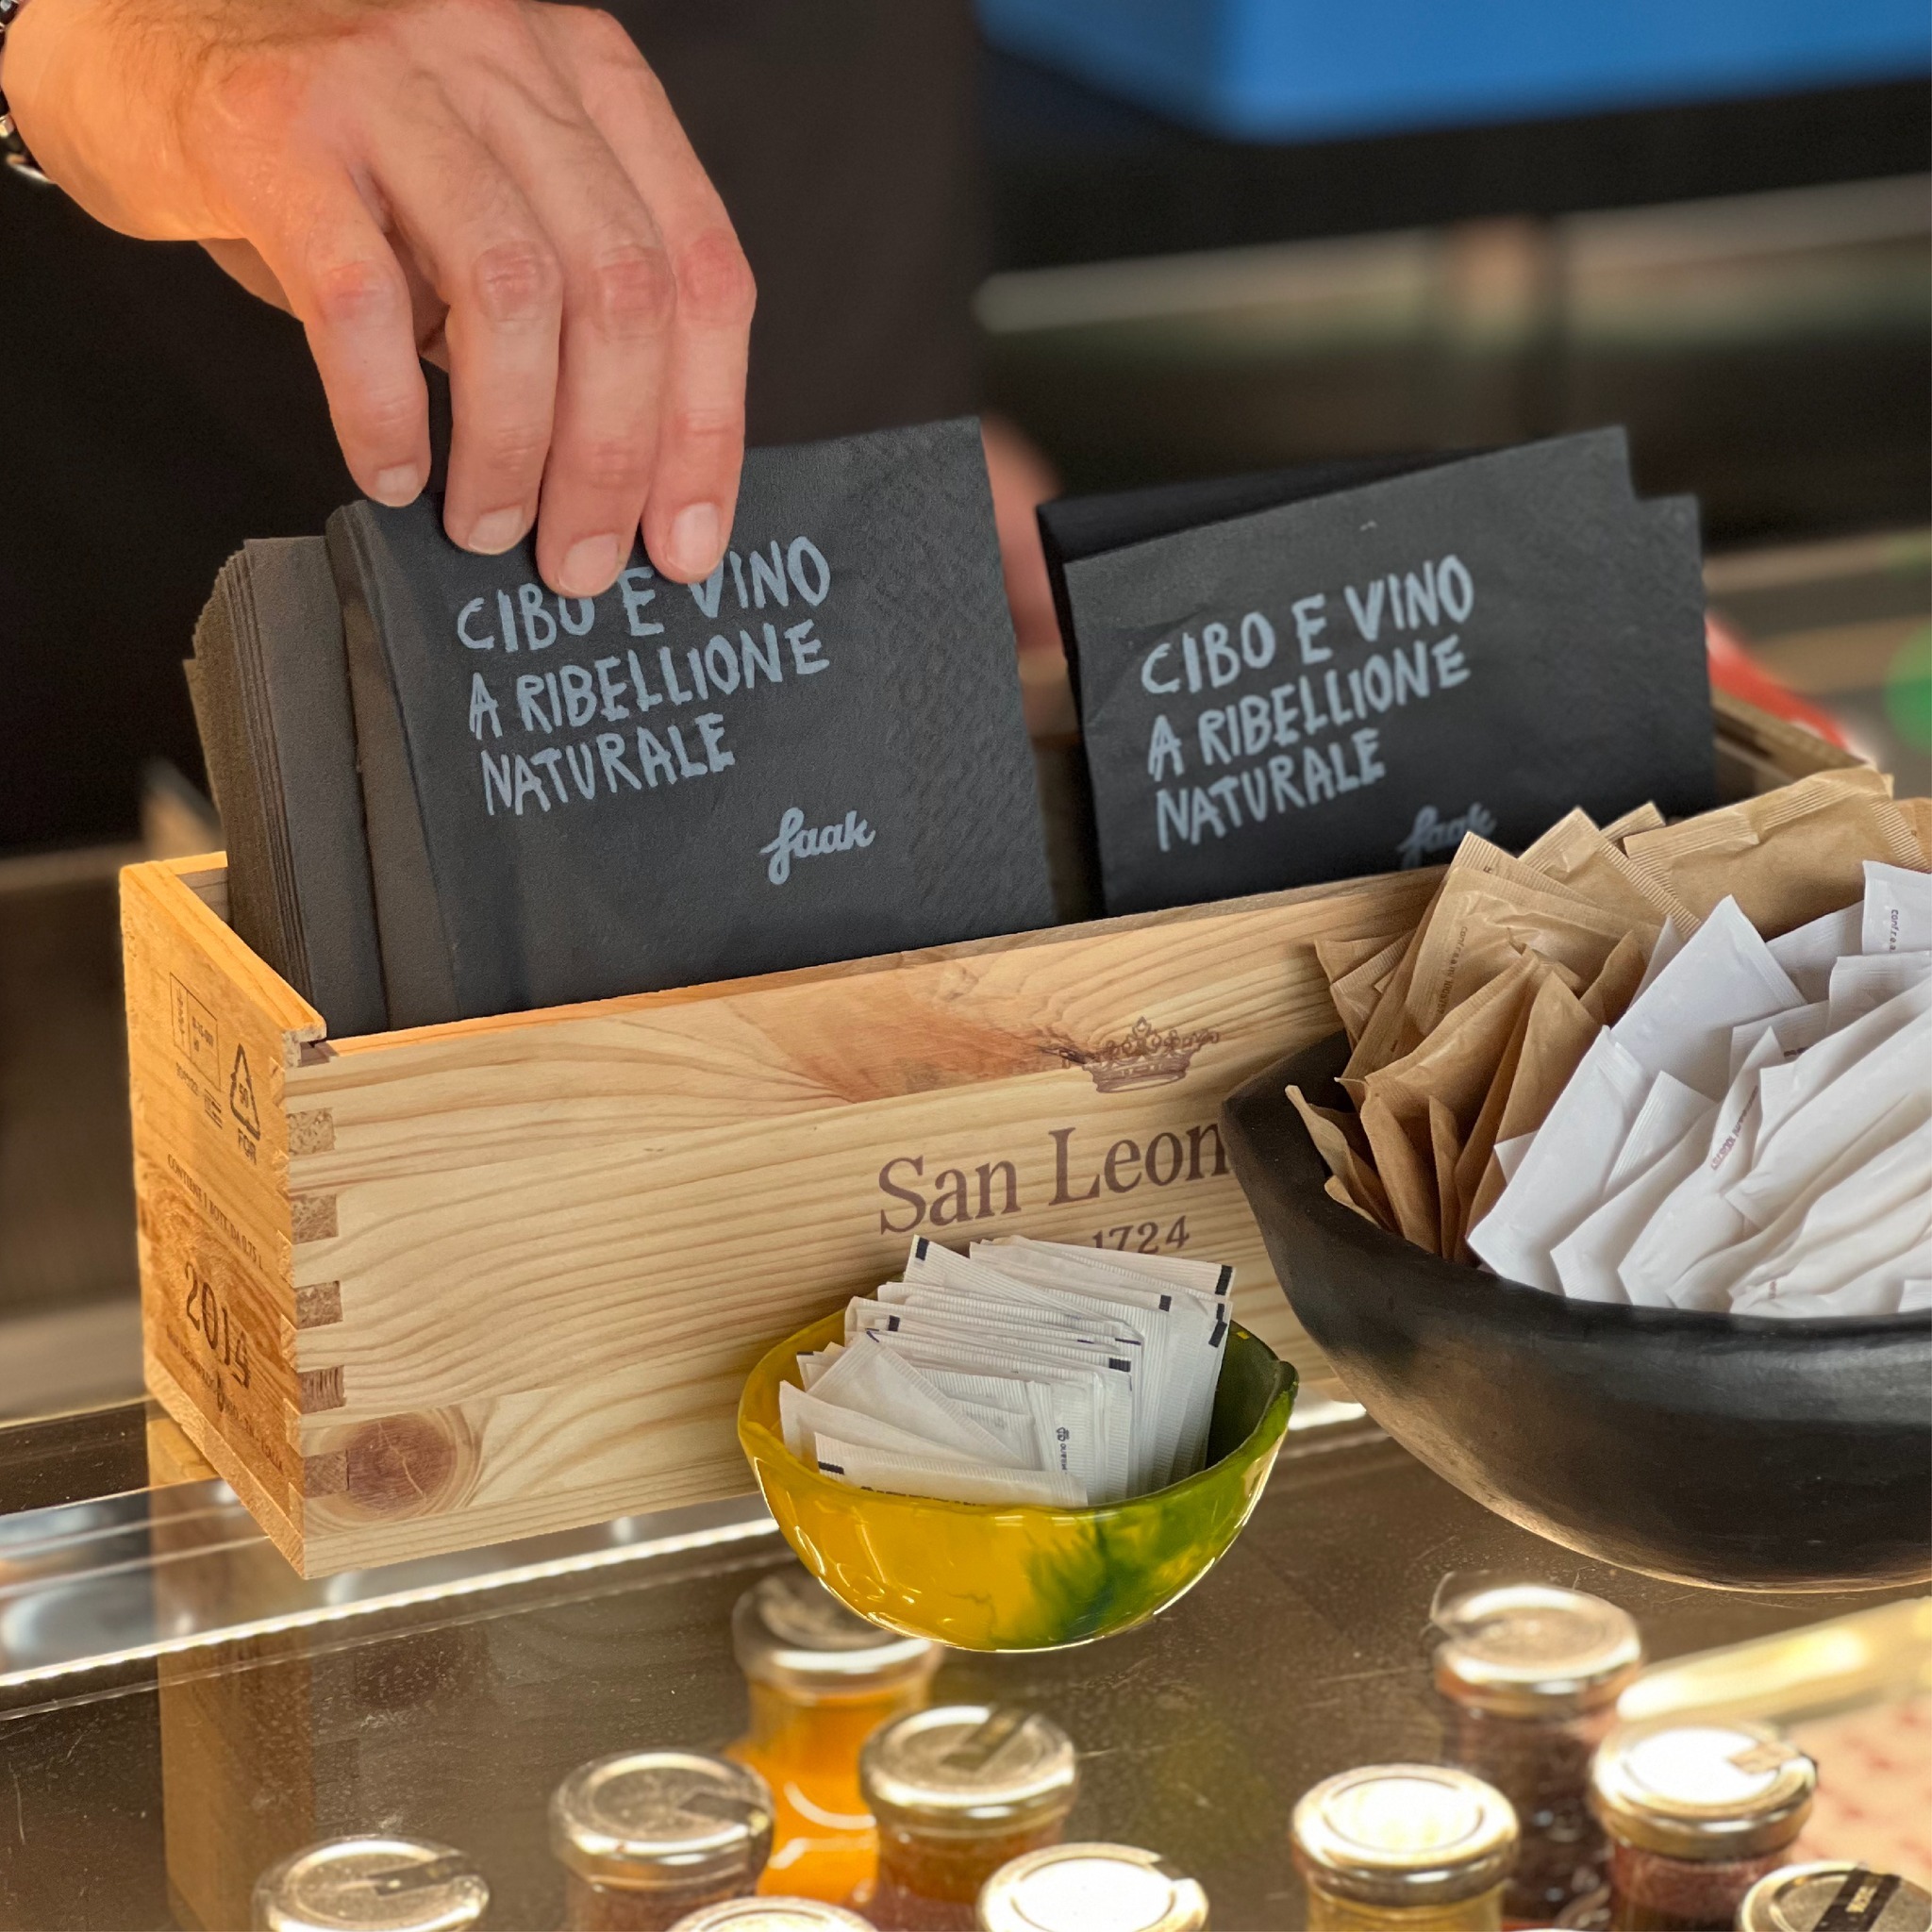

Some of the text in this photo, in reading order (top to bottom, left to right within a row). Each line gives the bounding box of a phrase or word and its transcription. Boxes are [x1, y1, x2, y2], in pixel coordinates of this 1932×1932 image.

[458, 536, 830, 652] CIBO E VINO
[1141, 555, 1474, 694] CIBO E VINO
[469, 619, 830, 740] A RIBELLIONE
[1147, 634, 1471, 782] A RIBELLIONE
[480, 712, 736, 815] NATURALE
[1157, 727, 1386, 851] NATURALE
[168, 1154, 202, 1203] CONTIENE
[878, 1123, 1231, 1235] San Leon
[1092, 1215, 1191, 1256] 1724
[185, 1261, 250, 1390] 2014
